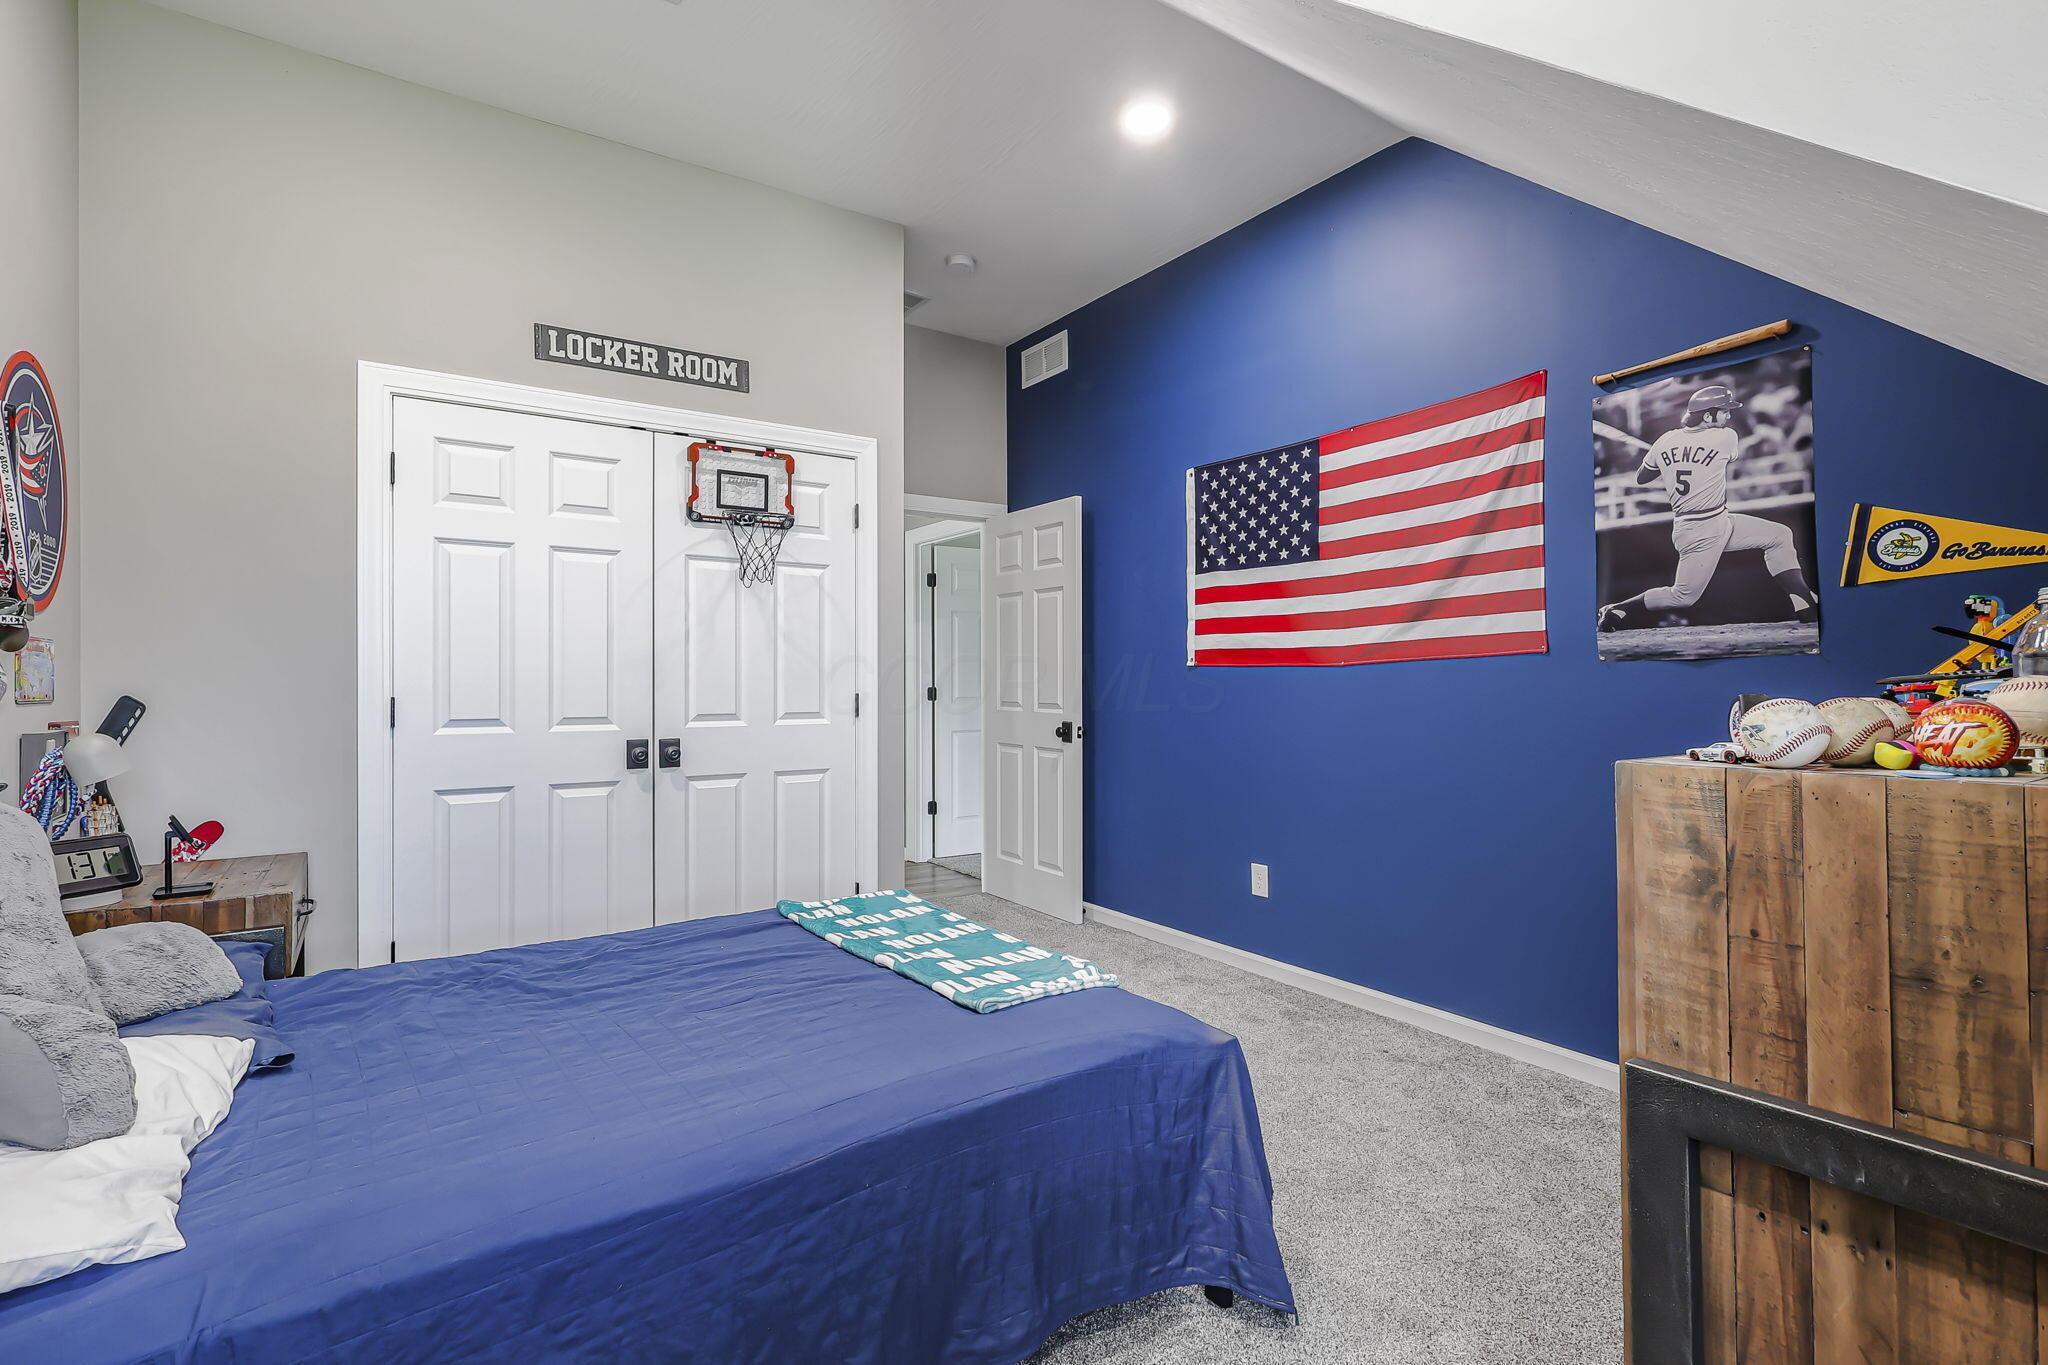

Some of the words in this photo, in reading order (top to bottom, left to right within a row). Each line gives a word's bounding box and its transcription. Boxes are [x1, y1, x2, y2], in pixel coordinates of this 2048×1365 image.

[547, 329, 659, 374] LOCKER
[667, 350, 738, 387] ROOM
[1660, 446, 1719, 467] BENCH
[4, 483, 14, 502] 2019
[1674, 470, 1693, 496] 5
[9, 512, 19, 531] 2019
[14, 541, 24, 560] 2019
[1941, 542, 1969, 560] Go
[1965, 541, 2048, 561] Bananas
[67, 850, 113, 881] 1:31
[834, 905, 936, 927] NOLAN
[880, 922, 988, 949] NOLAN
[936, 946, 1054, 975] NOLAN
